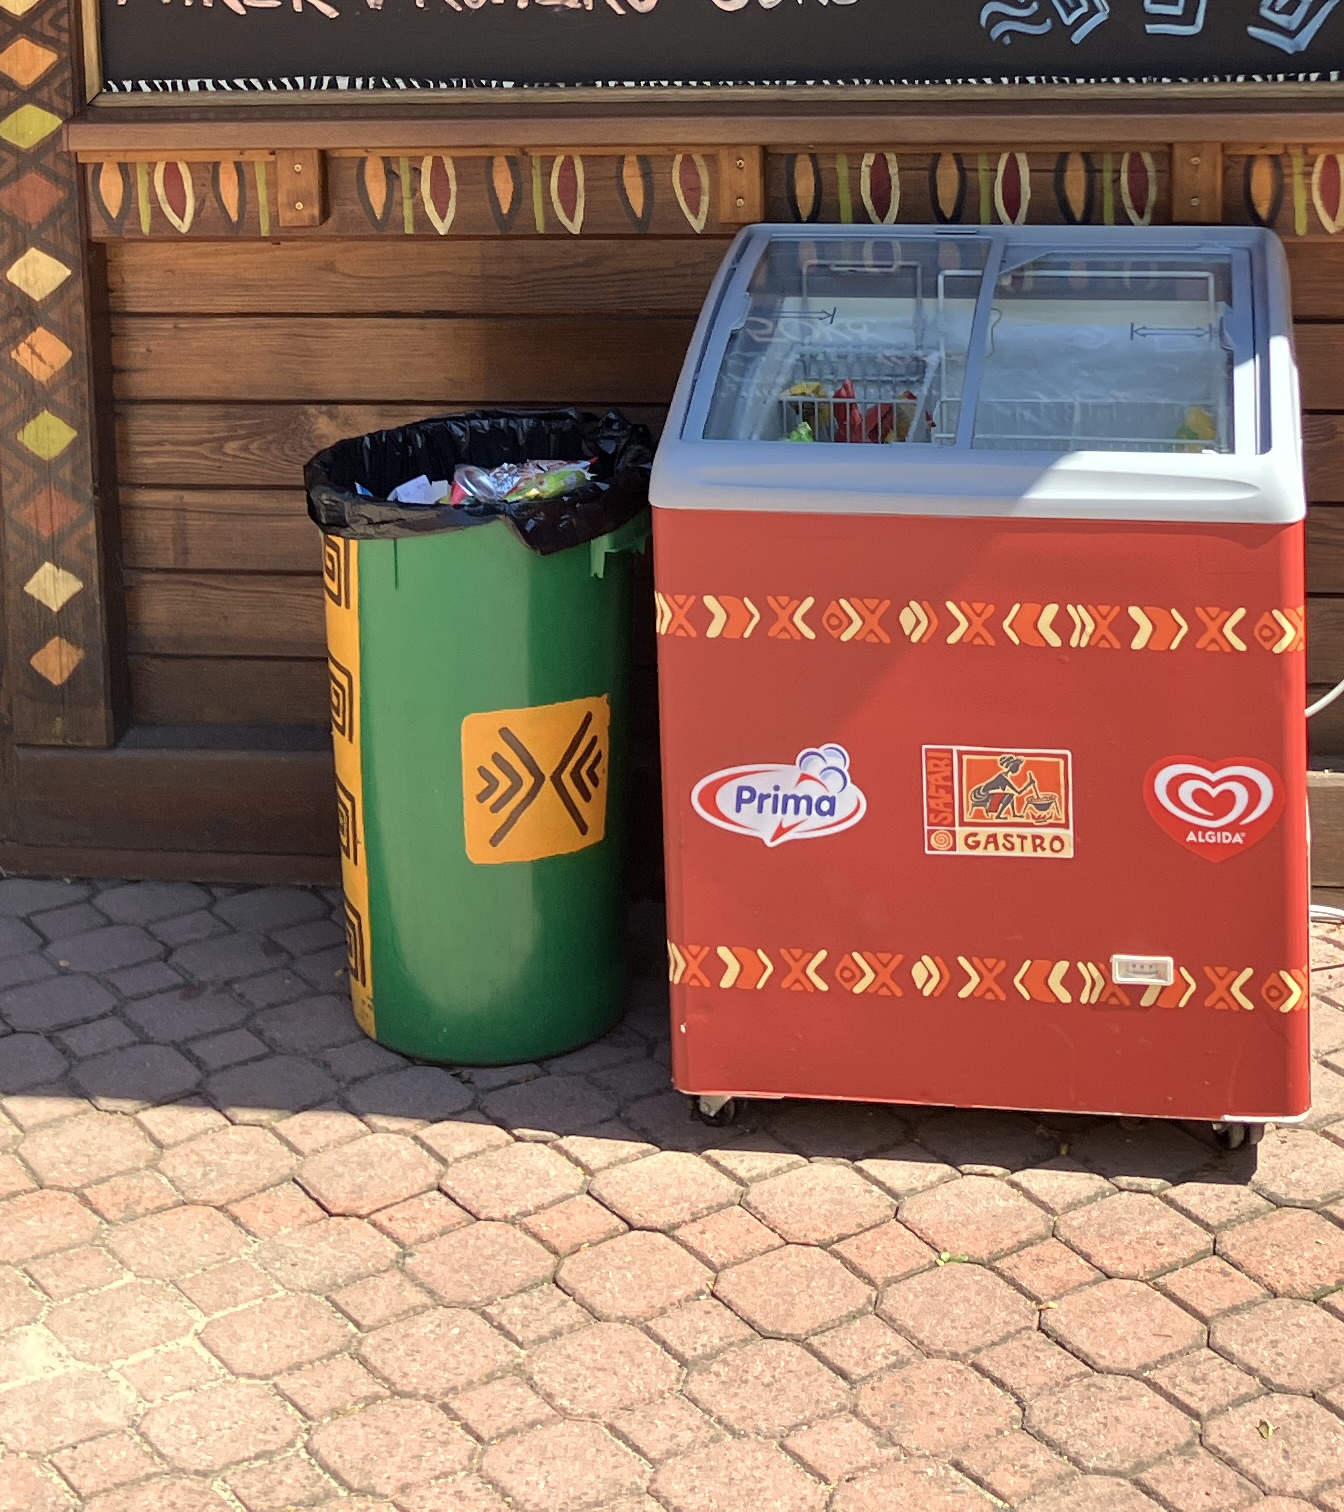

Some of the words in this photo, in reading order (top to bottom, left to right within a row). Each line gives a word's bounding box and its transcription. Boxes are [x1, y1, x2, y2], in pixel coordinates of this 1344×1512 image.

[735, 784, 837, 818] Prima
[927, 751, 954, 825] SAFARI
[963, 831, 1066, 855] GASTRO
[1185, 830, 1244, 845] ALGIDA
